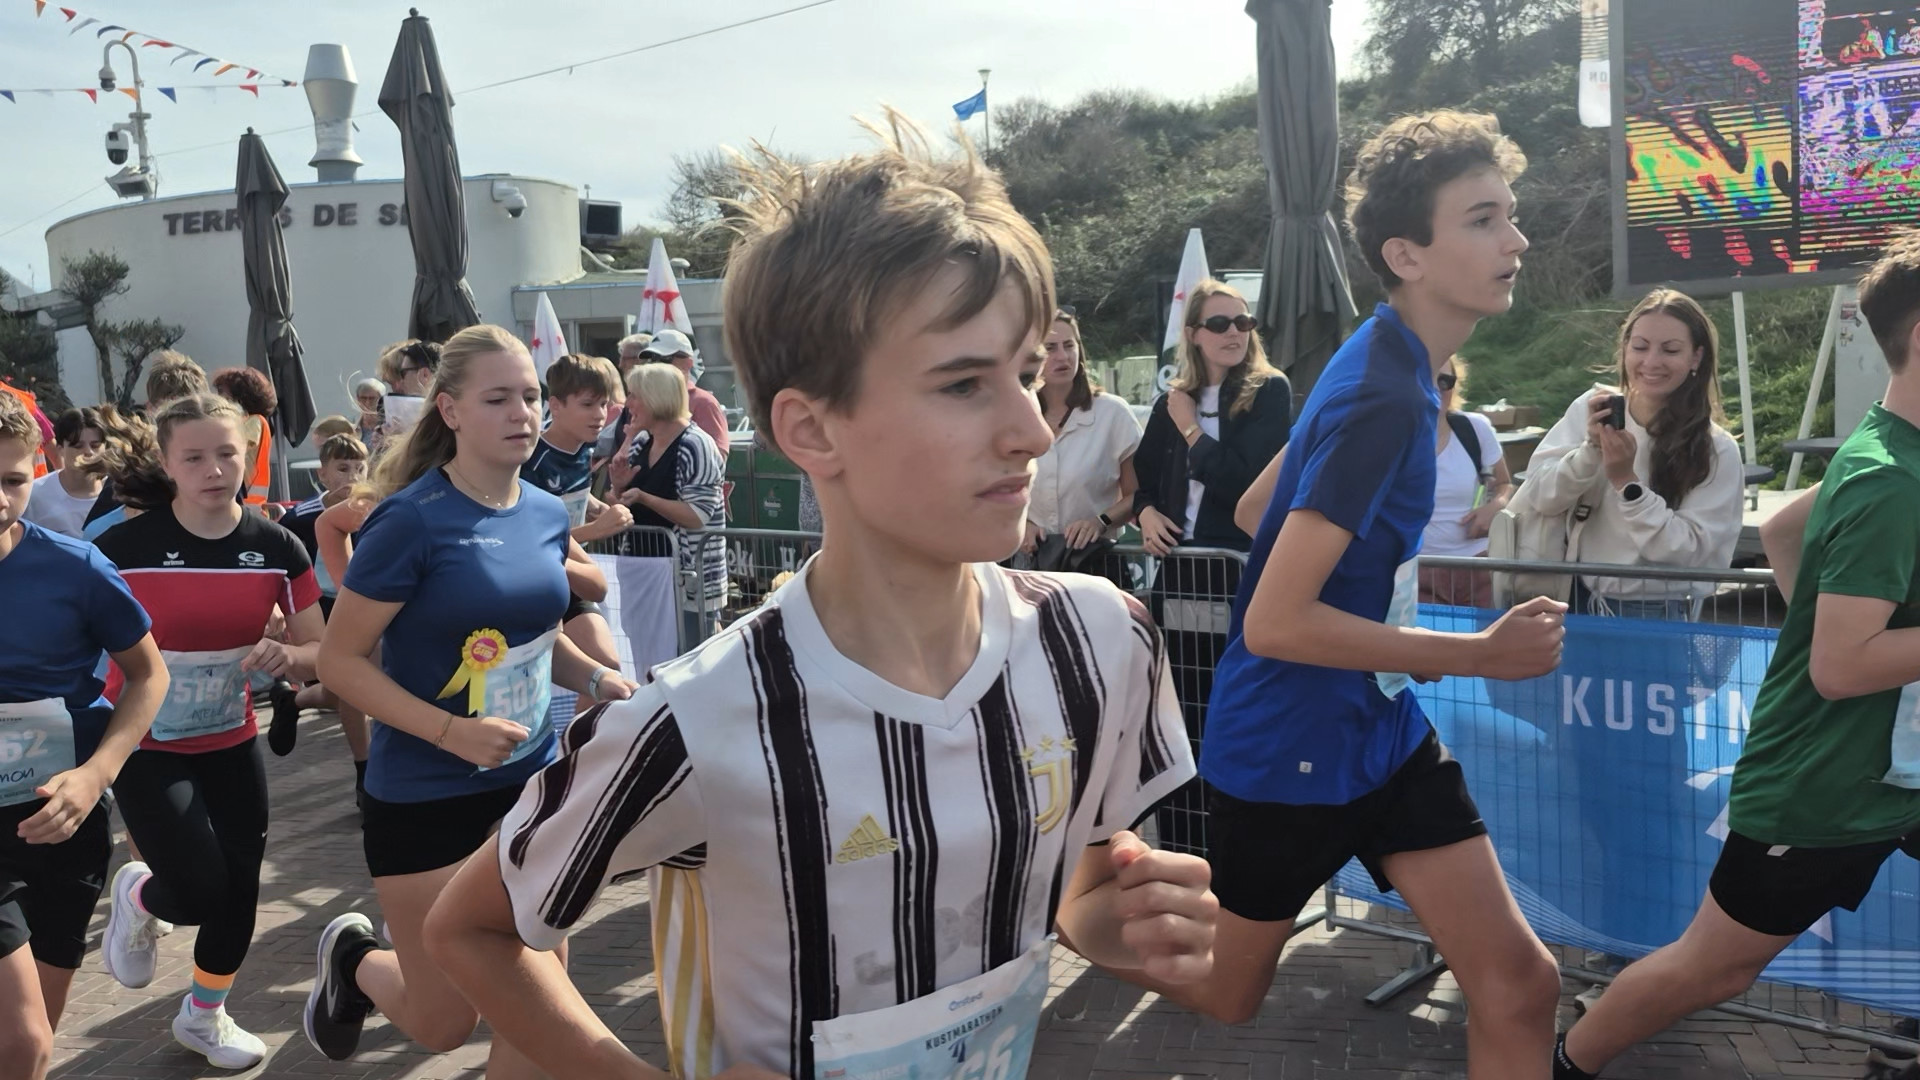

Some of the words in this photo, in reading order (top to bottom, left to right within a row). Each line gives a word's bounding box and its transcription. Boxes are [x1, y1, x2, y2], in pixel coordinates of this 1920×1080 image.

[163, 209, 292, 236] TERRS
[313, 203, 357, 227] DE
[835, 837, 899, 864] adidas
[925, 1005, 1003, 1051] KUSTMARATHON
